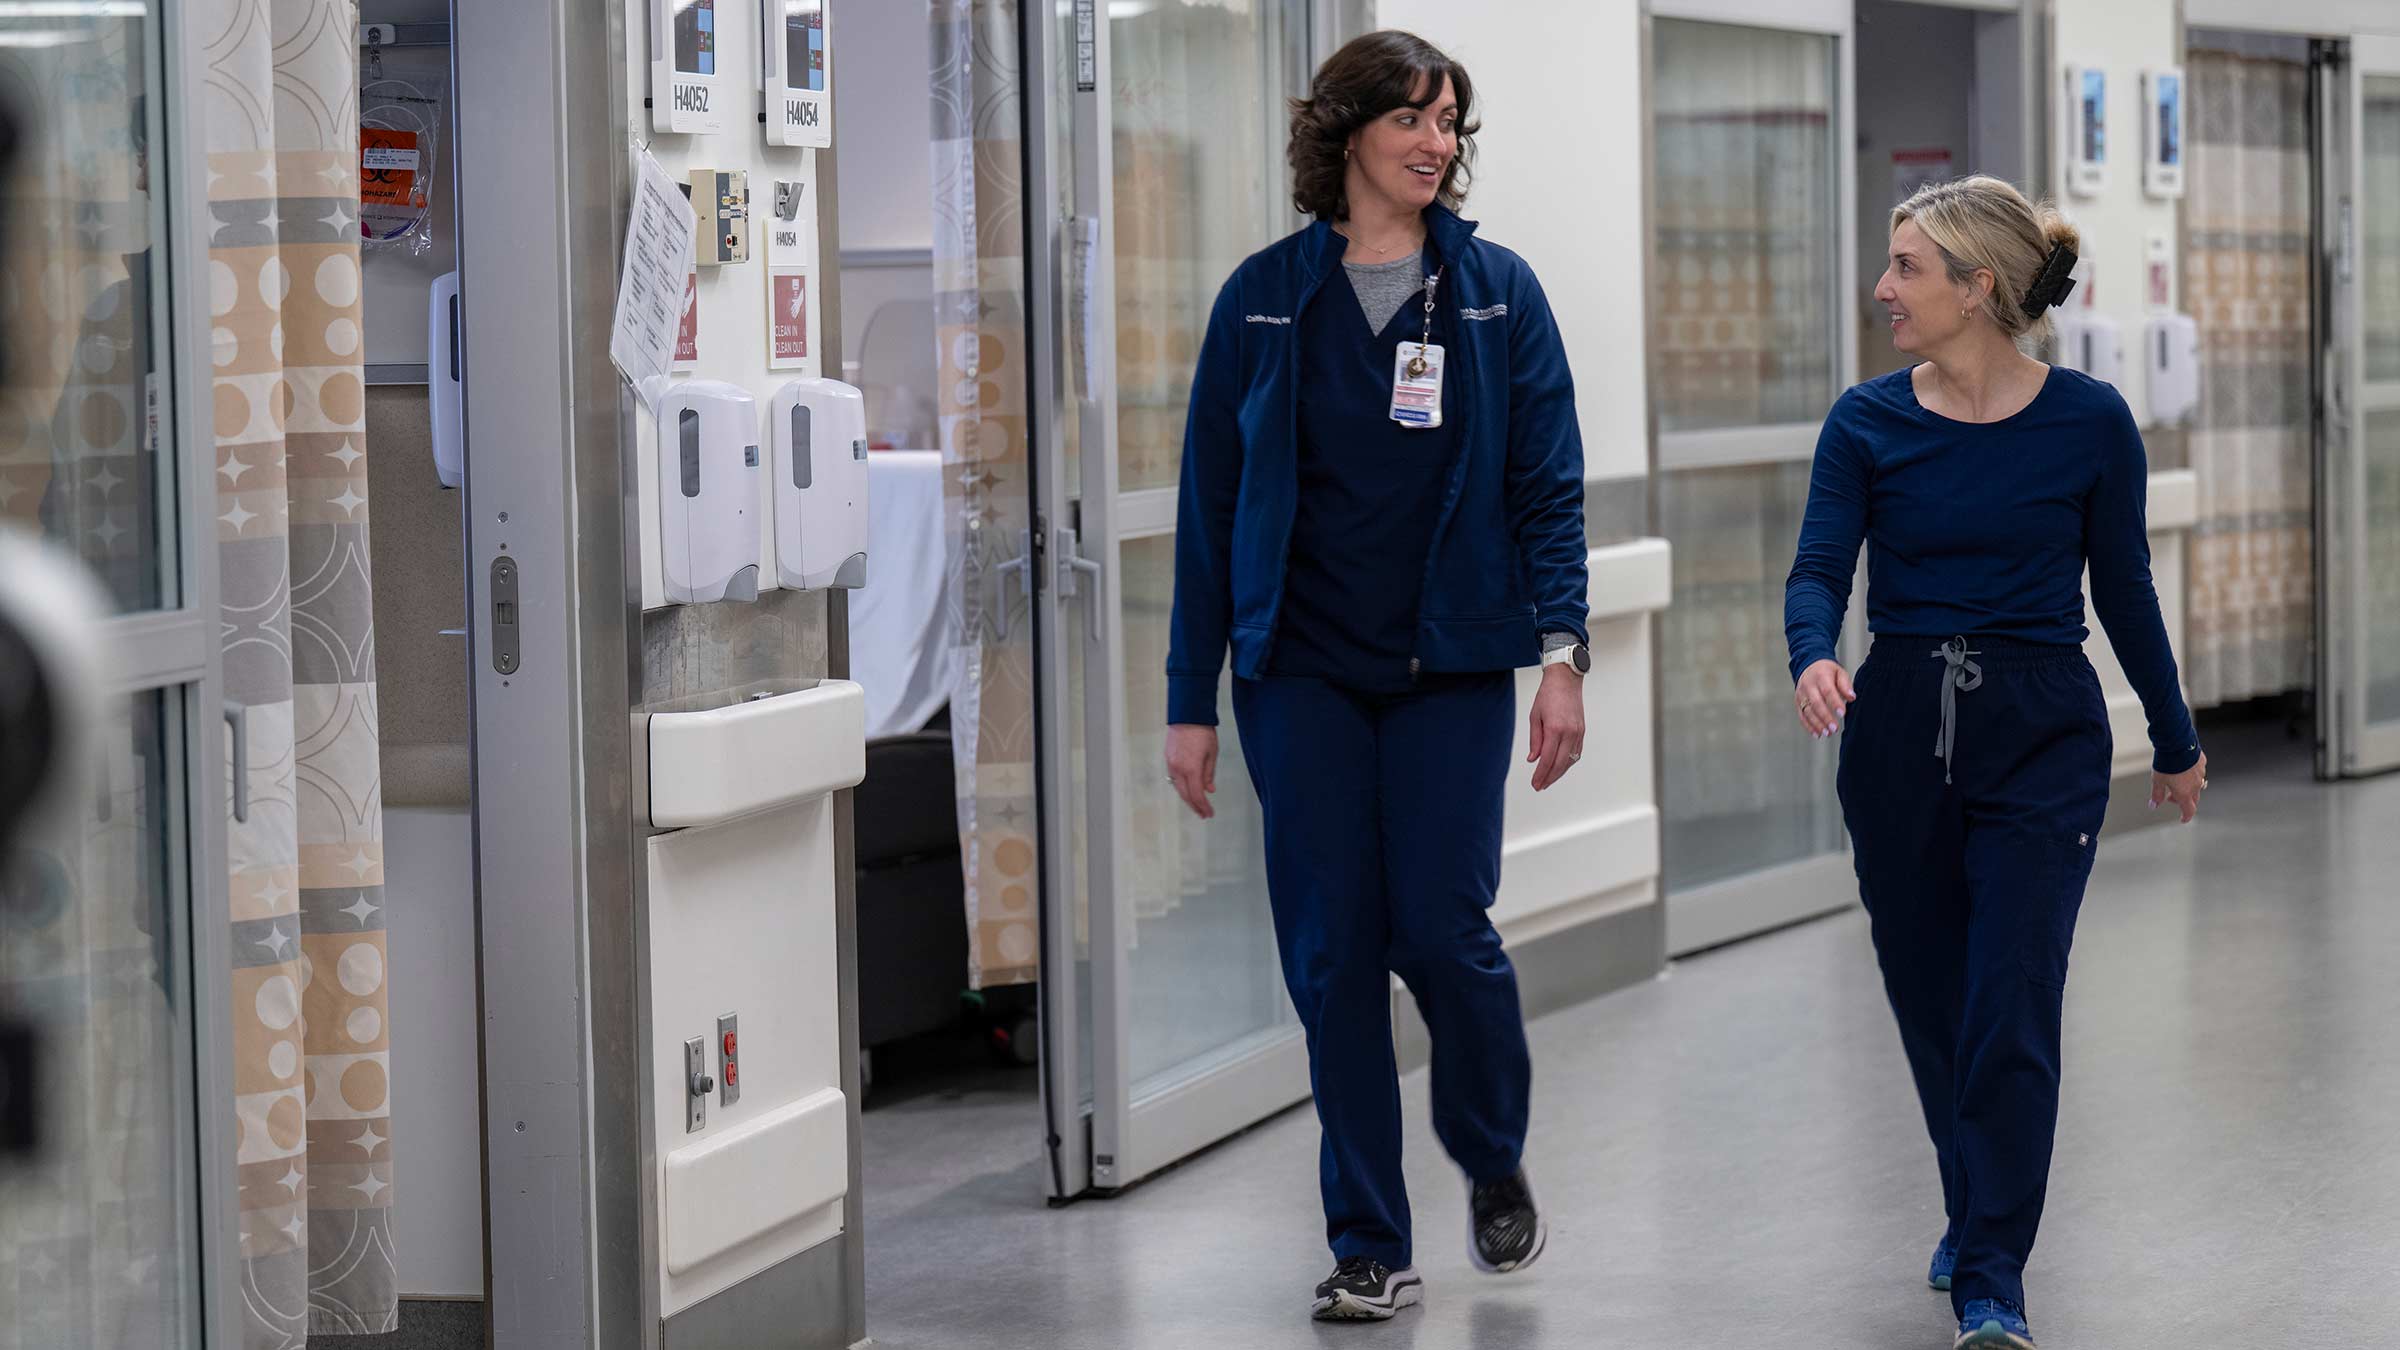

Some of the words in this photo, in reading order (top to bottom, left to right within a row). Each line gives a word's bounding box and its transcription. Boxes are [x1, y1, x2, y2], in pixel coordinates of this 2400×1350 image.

[674, 84, 709, 113] H4052
[786, 100, 819, 127] H4054
[776, 231, 797, 247] H4054
[775, 324, 791, 337] CLEAN
[792, 324, 798, 337] IN
[682, 342, 693, 355] OUT
[775, 341, 792, 354] CLEAN
[792, 341, 803, 353] OUT
